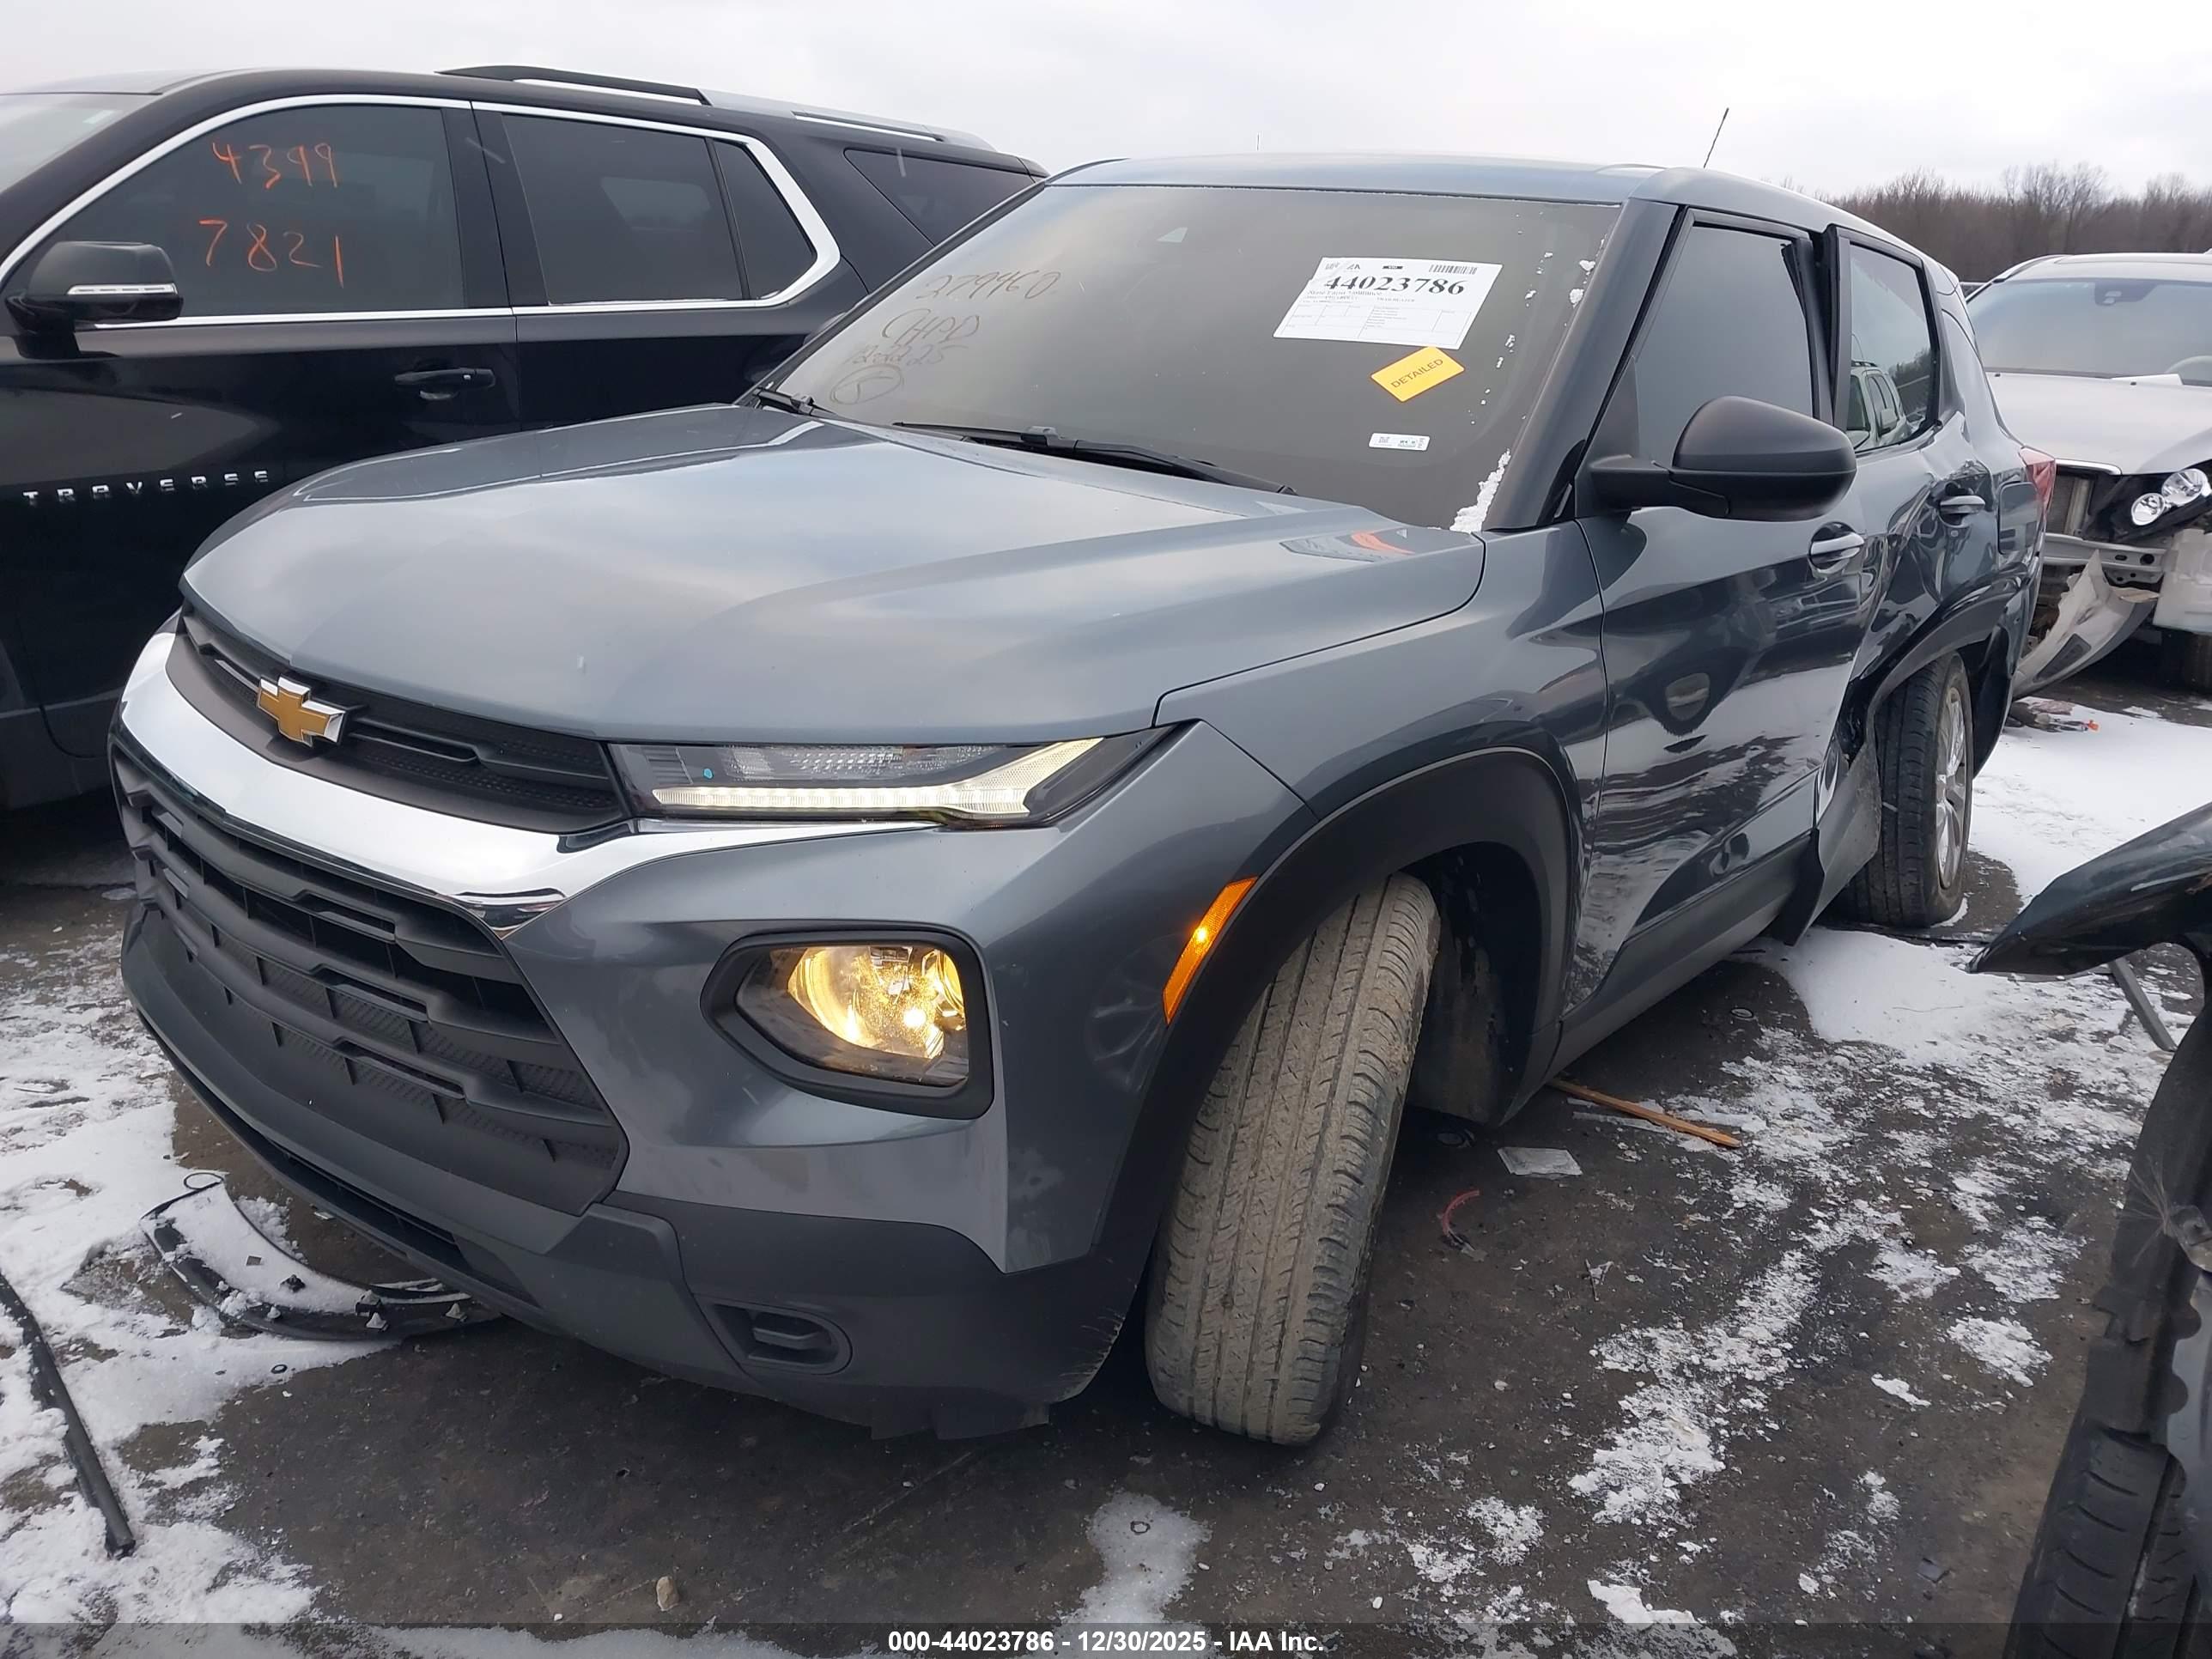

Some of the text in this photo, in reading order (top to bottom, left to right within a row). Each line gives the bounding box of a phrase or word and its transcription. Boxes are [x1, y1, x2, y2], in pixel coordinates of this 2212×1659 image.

[199, 218, 344, 289] 7821
[1324, 276, 1466, 295] 44023786
[1391, 359, 1443, 388] DETAILED
[22, 469, 269, 507] TRAVERSE
